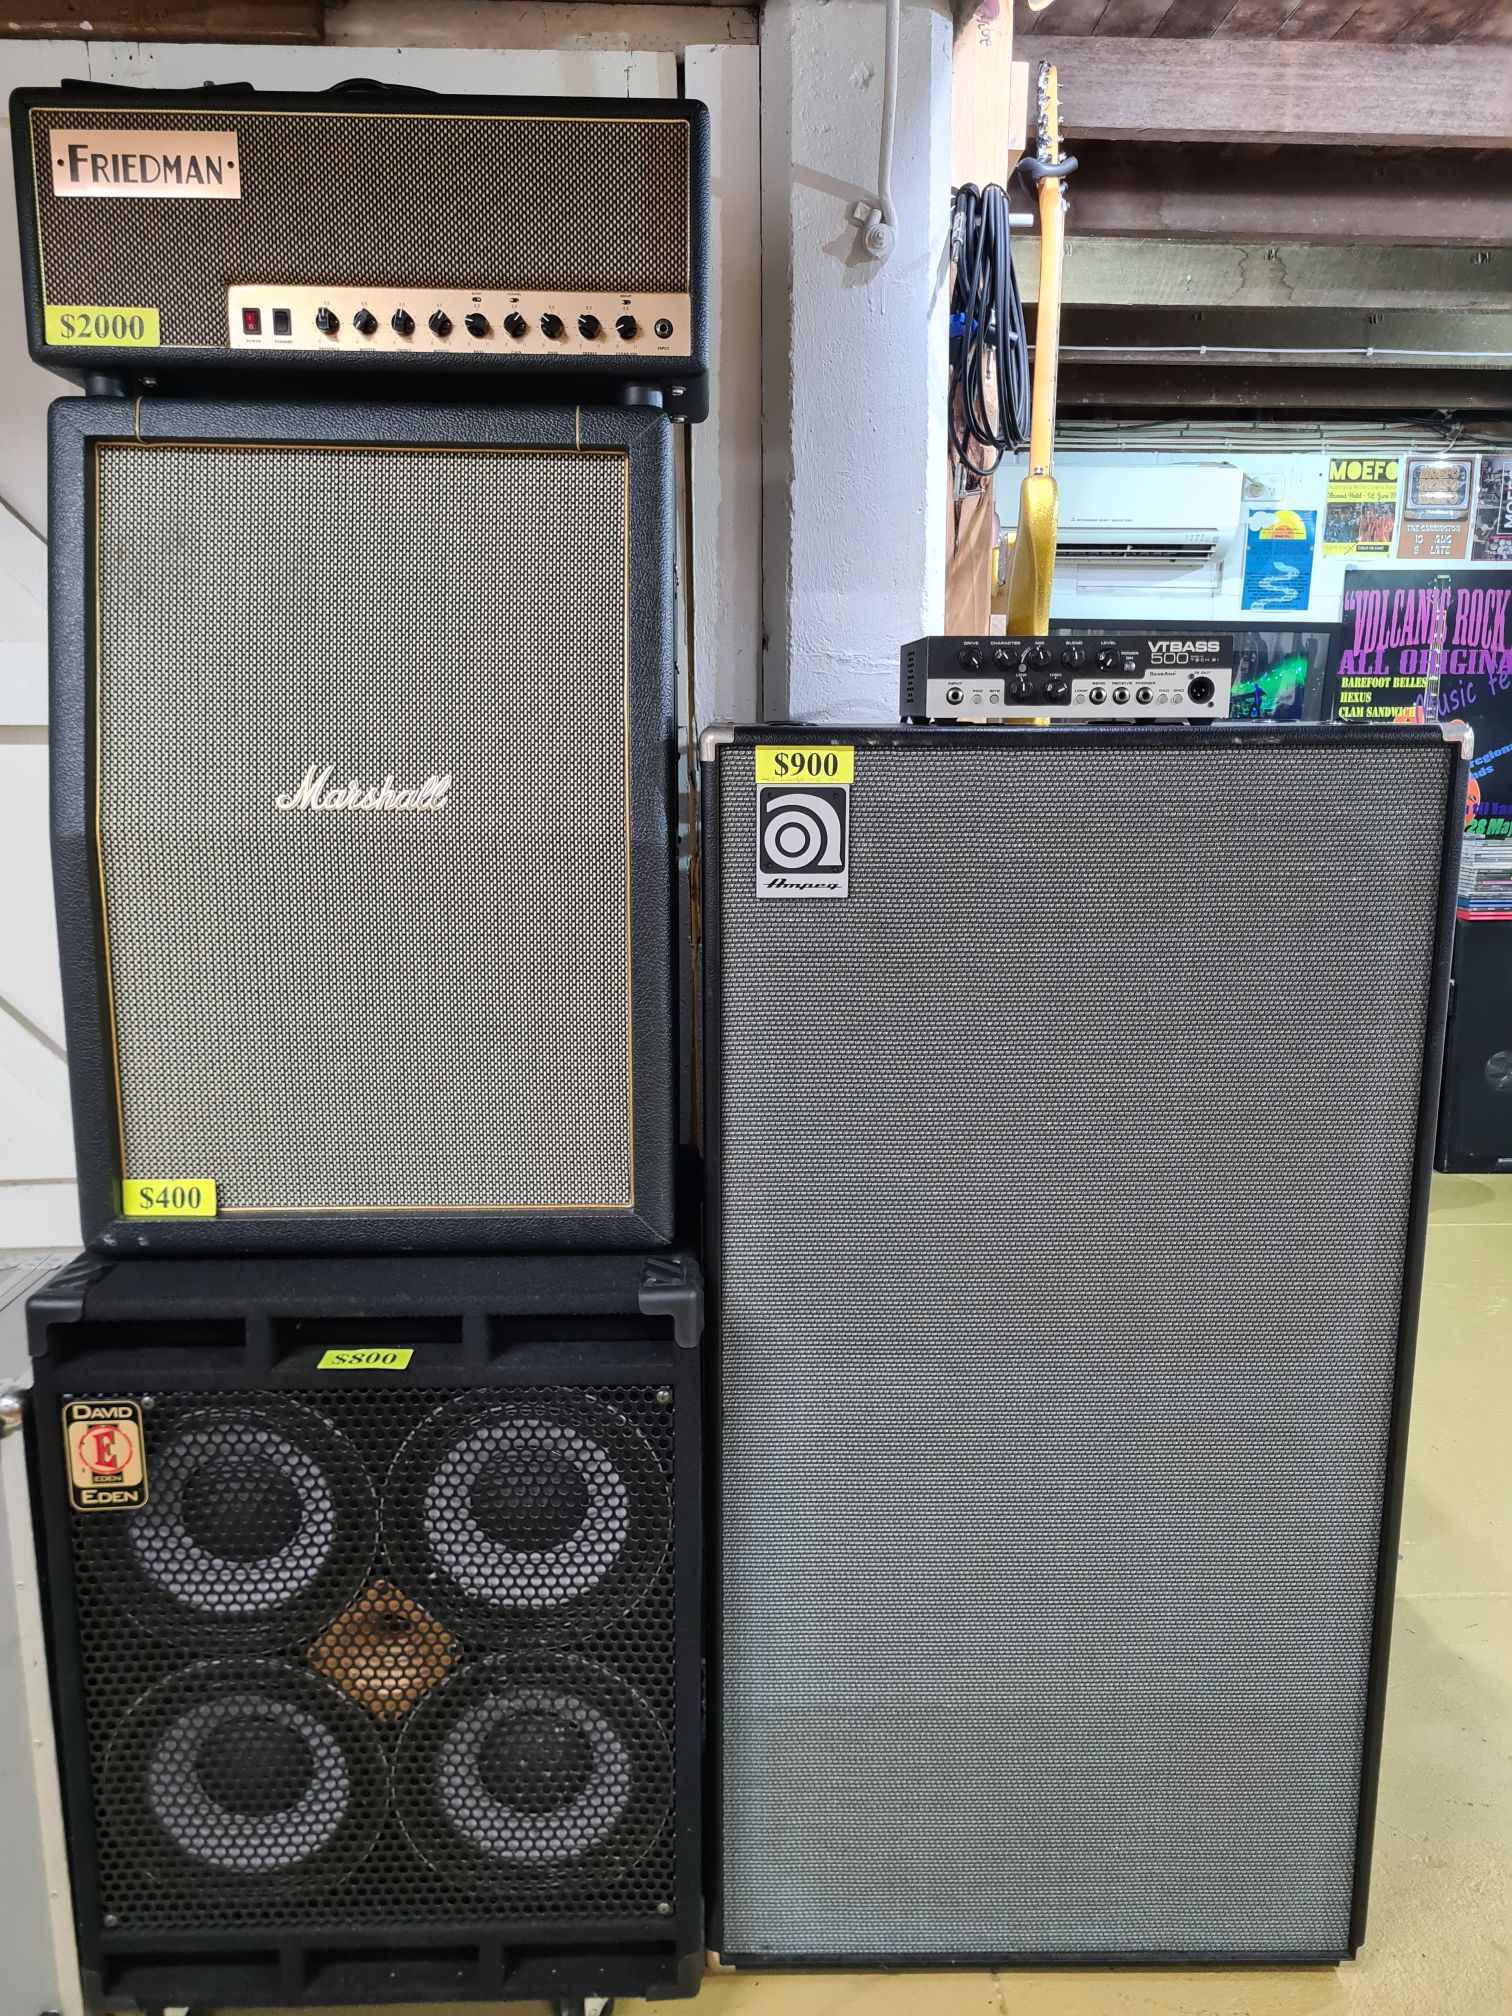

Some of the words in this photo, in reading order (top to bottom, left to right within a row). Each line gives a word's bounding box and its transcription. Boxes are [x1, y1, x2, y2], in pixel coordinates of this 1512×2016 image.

[68, 144, 223, 185] FRIEDMAN
[60, 313, 144, 340] $2000
[1434, 534, 1452, 544] AUG
[1430, 546, 1451, 554] LATE
[1452, 588, 1512, 653] ROCK
[1148, 641, 1220, 653] VTBASS
[1150, 653, 1189, 664] 500
[1336, 649, 1390, 676] ALL
[1341, 676, 1392, 688] BAREFOOT
[1392, 676, 1428, 688] BELLES
[1340, 692, 1372, 703] HEXUS
[1338, 706, 1364, 718] CLAM
[1366, 706, 1417, 718] SANDWICH
[774, 752, 838, 778] $900
[275, 764, 452, 812] Marshall
[1466, 818, 1488, 835] 28
[763, 878, 842, 890] Ampeg
[140, 1186, 202, 1210] $400
[331, 1352, 398, 1365] $800
[72, 1404, 133, 1420] DAVID
[93, 1430, 118, 1469] E
[81, 1489, 139, 1505] EDEN
